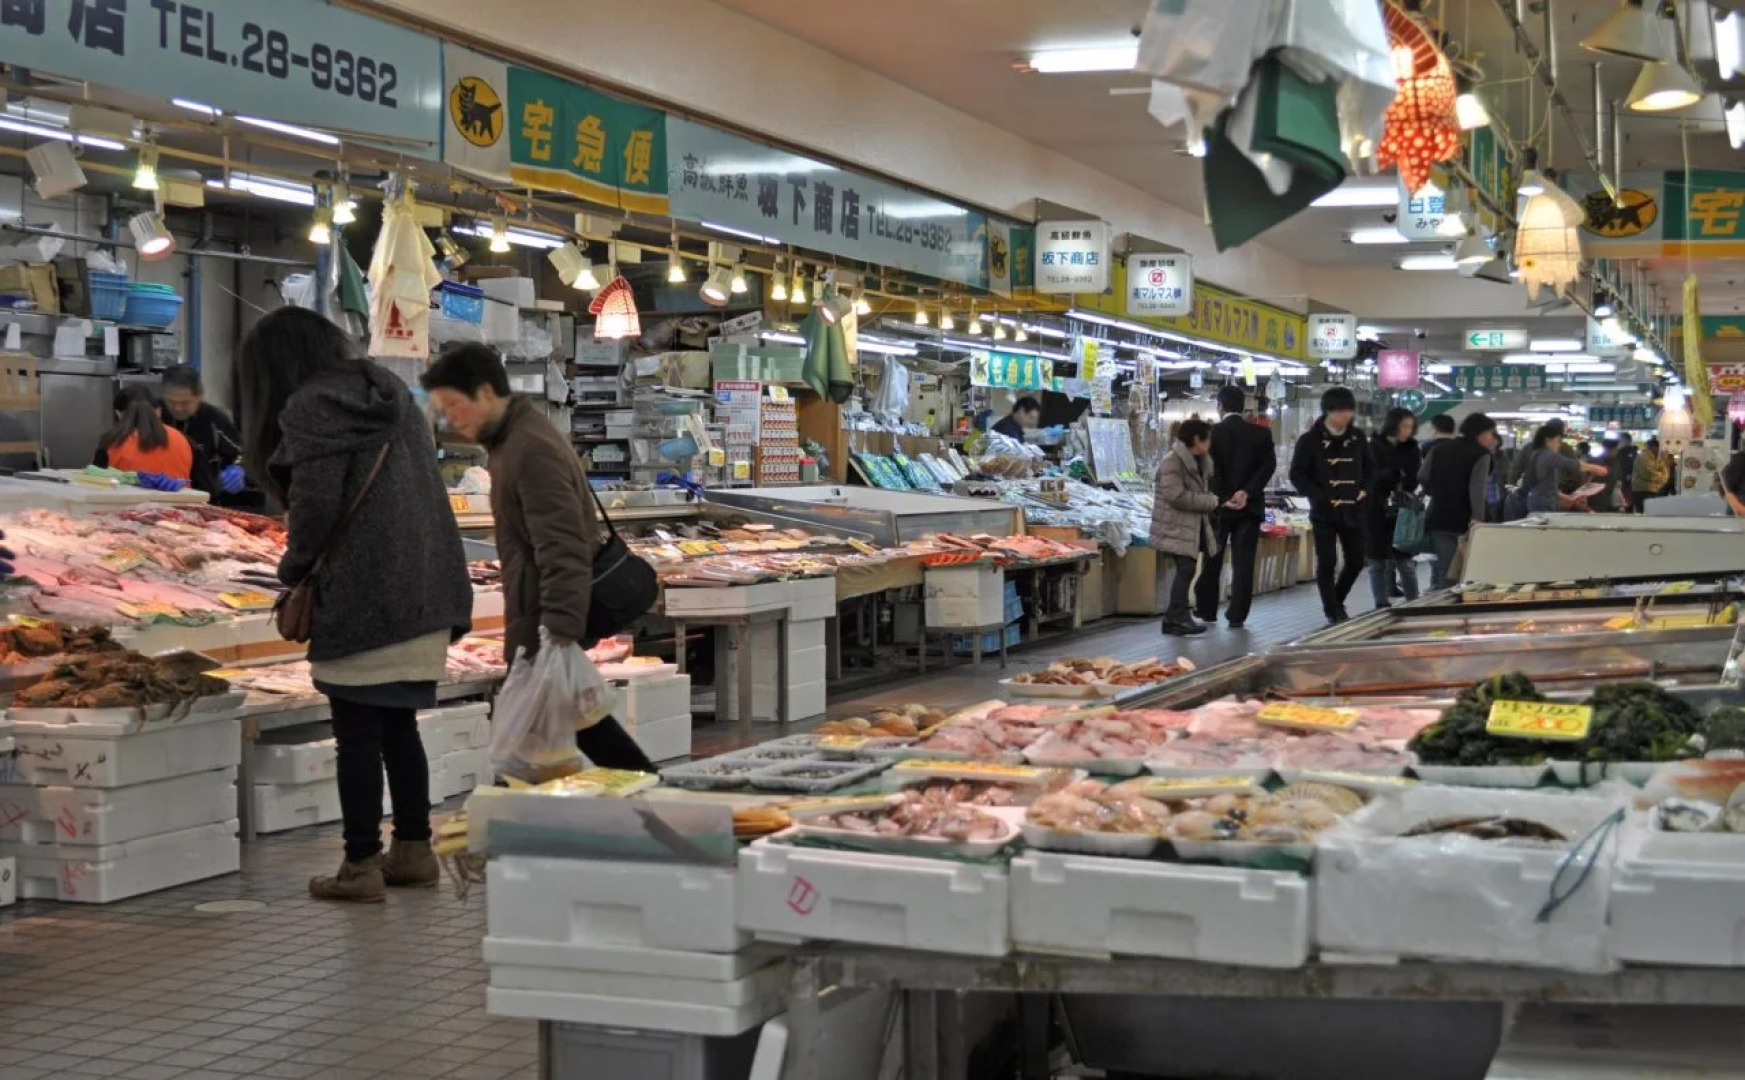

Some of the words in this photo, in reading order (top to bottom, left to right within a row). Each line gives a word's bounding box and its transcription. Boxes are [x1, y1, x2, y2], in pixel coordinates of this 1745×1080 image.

[150, 0, 398, 108] TEL.28-9362
[522, 100, 653, 184] 宅急便
[1041, 251, 1100, 266] 坂下商店
